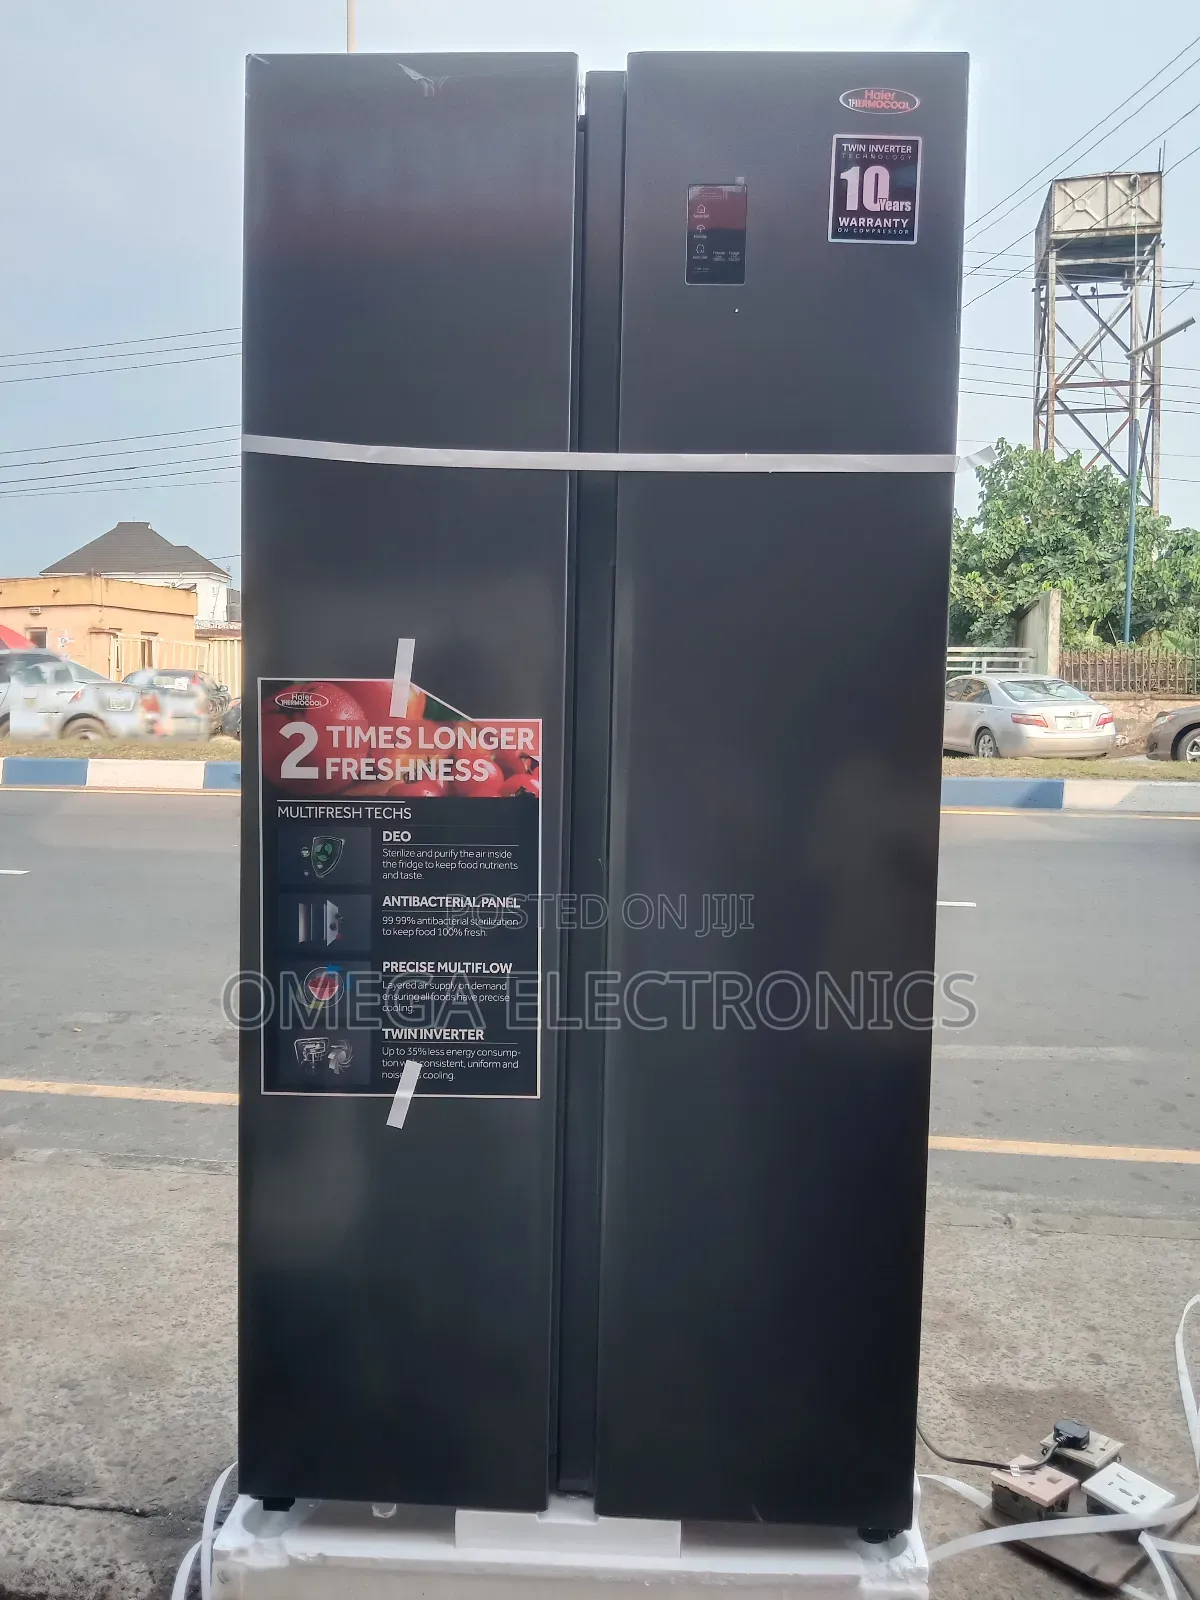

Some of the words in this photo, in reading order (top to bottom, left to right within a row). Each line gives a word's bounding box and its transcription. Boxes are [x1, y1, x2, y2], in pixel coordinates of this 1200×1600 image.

[864, 90, 896, 100] Haier
[848, 99, 910, 110] THERMOCOOL
[842, 144, 866, 152] TWIN
[868, 144, 912, 154] INVERTER
[840, 166, 890, 211] 10
[880, 198, 912, 212] Years
[838, 216, 909, 228] WARRANTY
[279, 721, 318, 779] 2
[326, 726, 412, 749] TIMES
[418, 726, 534, 750] LONGER
[326, 758, 489, 781] FRESHNESS
[278, 806, 362, 819] MULTIFRESH
[365, 807, 412, 819] TECHS
[382, 831, 412, 842] DEO
[382, 848, 415, 858] Sterilize
[416, 849, 433, 858] and
[434, 849, 458, 860] purify
[460, 850, 474, 858] the
[476, 850, 486, 858] air
[487, 850, 512, 859] inside
[382, 860, 398, 868] the
[398, 860, 424, 870] fridge
[435, 861, 456, 870] keep
[458, 860, 478, 869] food
[480, 861, 518, 870] nutrients
[382, 871, 398, 880] and
[400, 872, 424, 880] taste.
[382, 896, 480, 908] ANTIBACTERIAL
[482, 897, 520, 908] PANEL
[382, 916, 416, 925] 99.99%
[416, 916, 469, 926] antibacterial
[470, 917, 519, 926] sterilization
[382, 928, 392, 936] to
[393, 928, 414, 938] keep
[415, 927, 436, 936] food
[438, 928, 463, 936] 100%
[464, 928, 488, 937] fresh.
[382, 962, 435, 973] PRECISE
[438, 962, 513, 974] MULTIFLOW
[382, 981, 417, 991] Layered
[418, 982, 428, 990] air
[430, 981, 457, 992] supply
[471, 982, 507, 990] demand
[382, 993, 420, 1002] ensuring
[420, 992, 430, 1000] all
[431, 992, 456, 1001] foods
[456, 993, 478, 1002] have
[479, 994, 510, 1003] precise
[382, 1028, 420, 1040] TWIN
[420, 1029, 484, 1040] INVERTER
[382, 1047, 396, 1058] Up
[396, 1047, 405, 1056] to
[407, 1048, 426, 1056] 35%
[428, 1048, 444, 1056] less
[446, 1050, 475, 1058] energy
[477, 1050, 521, 1058] consump-
[382, 1059, 399, 1067] tion
